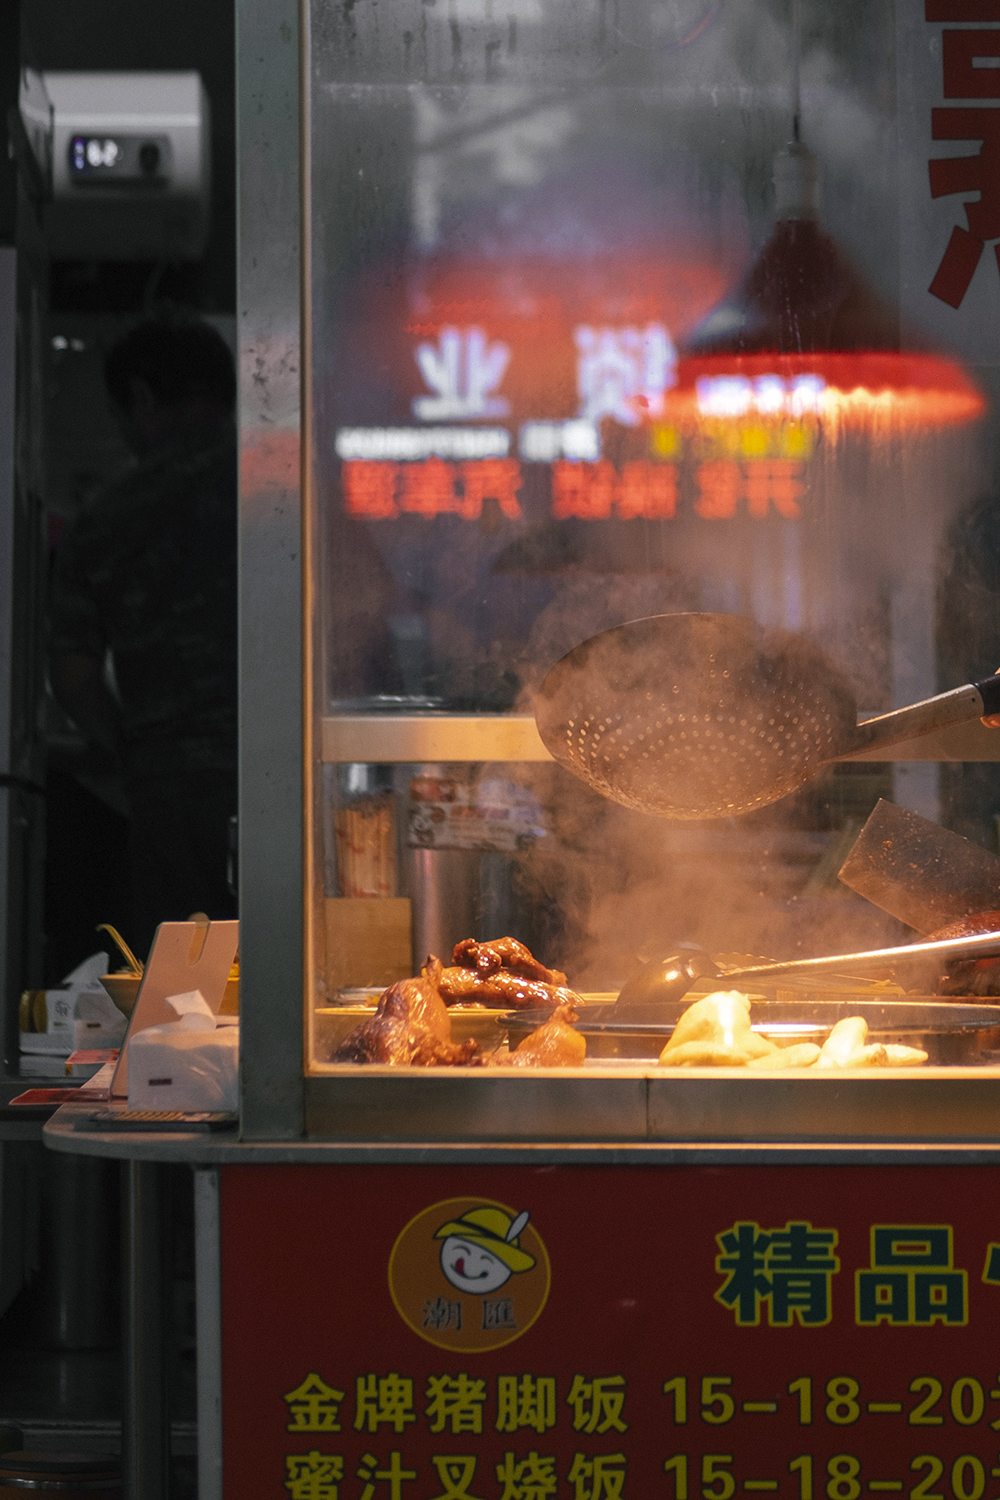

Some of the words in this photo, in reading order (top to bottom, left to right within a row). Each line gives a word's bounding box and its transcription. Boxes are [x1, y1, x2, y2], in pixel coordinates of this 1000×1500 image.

[284, 1373, 629, 1434] 金牌猪脚饭
[284, 1450, 629, 1500] 蜜汁叉烧饭
